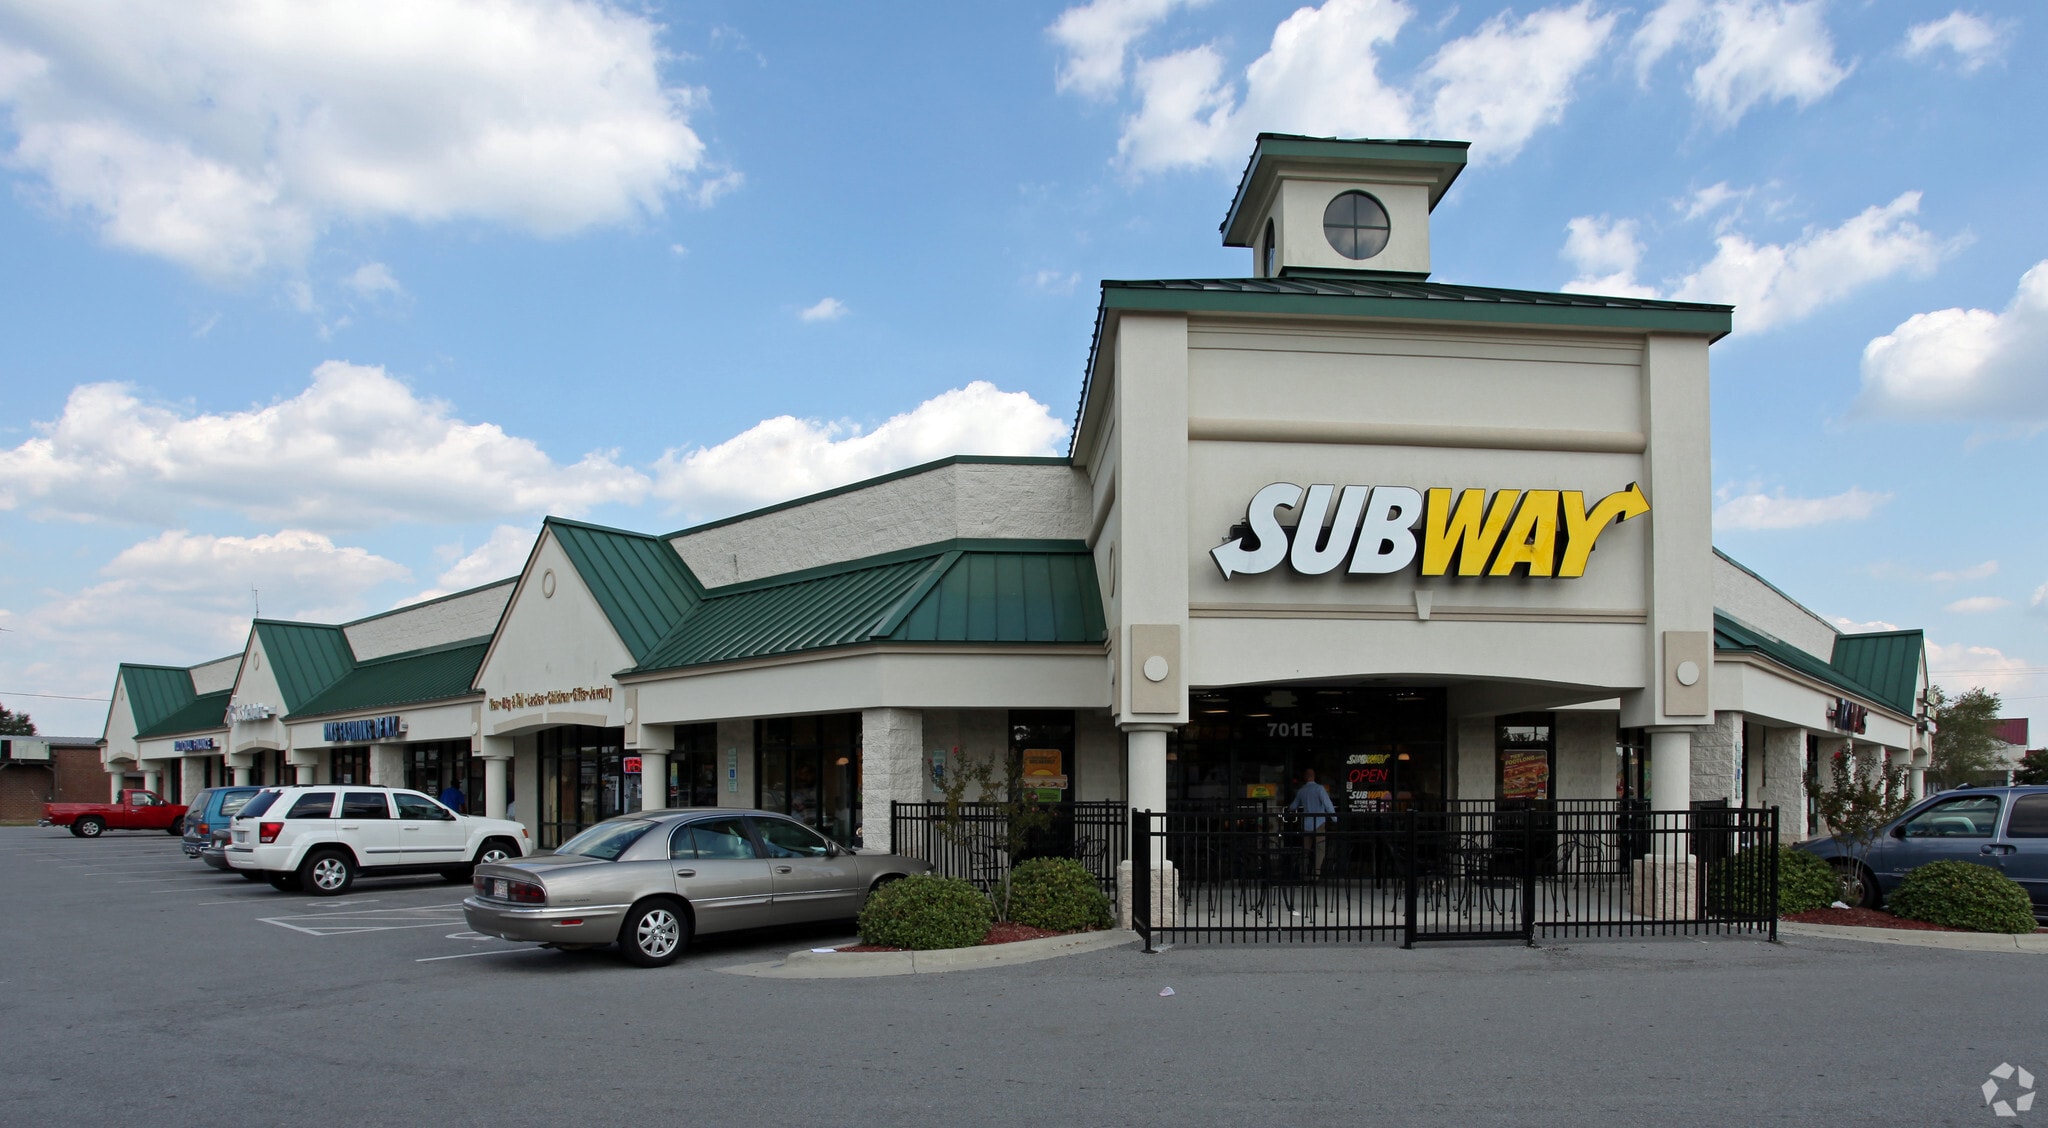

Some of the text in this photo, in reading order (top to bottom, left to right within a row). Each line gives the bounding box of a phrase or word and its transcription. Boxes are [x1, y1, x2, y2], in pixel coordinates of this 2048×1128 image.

[1209, 481, 1651, 580] SUBWAY
[340, 719, 372, 741] FASHIONS
[375, 717, 384, 738] OF
[1267, 722, 1313, 737] 701E
[1346, 754, 1391, 764] SUBWAY
[1349, 769, 1388, 782] OPEN
[1349, 790, 1391, 800] SUBWAY
